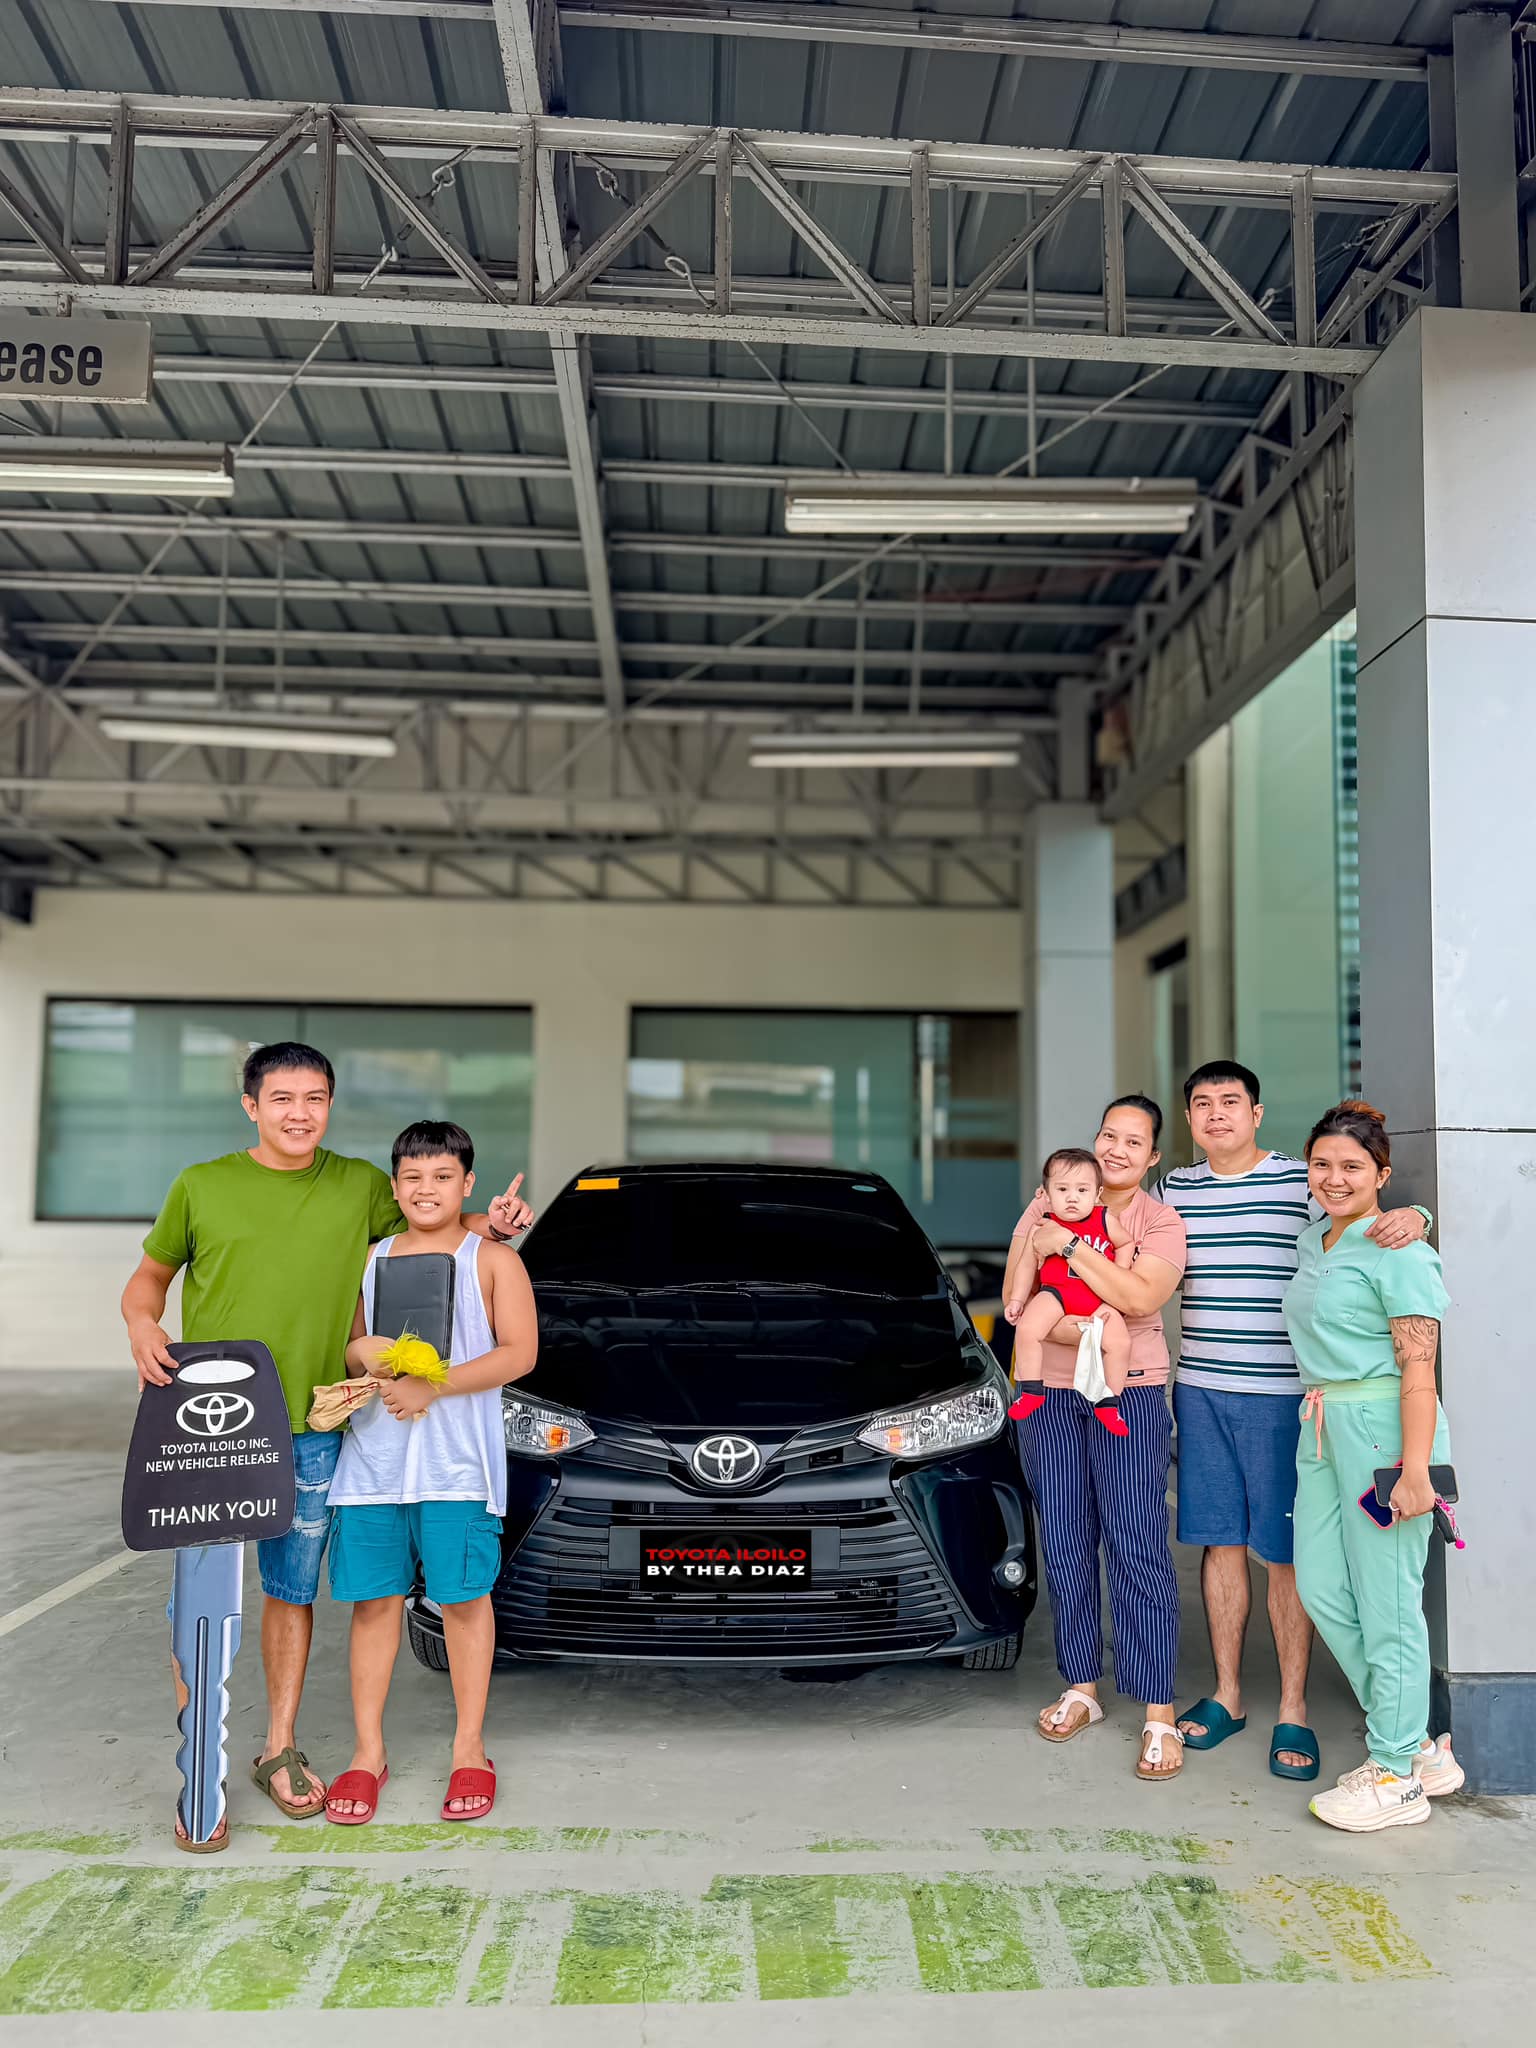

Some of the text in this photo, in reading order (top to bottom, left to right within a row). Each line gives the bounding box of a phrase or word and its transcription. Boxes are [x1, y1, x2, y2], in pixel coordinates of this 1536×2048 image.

[160, 1437, 272, 1456] TOYOTA ILOILO INC.
[145, 1451, 280, 1473] NEW VEHICLE RELEASE
[148, 1498, 277, 1527] THANK YOU!
[1400, 1783, 1424, 1805] HOKA
